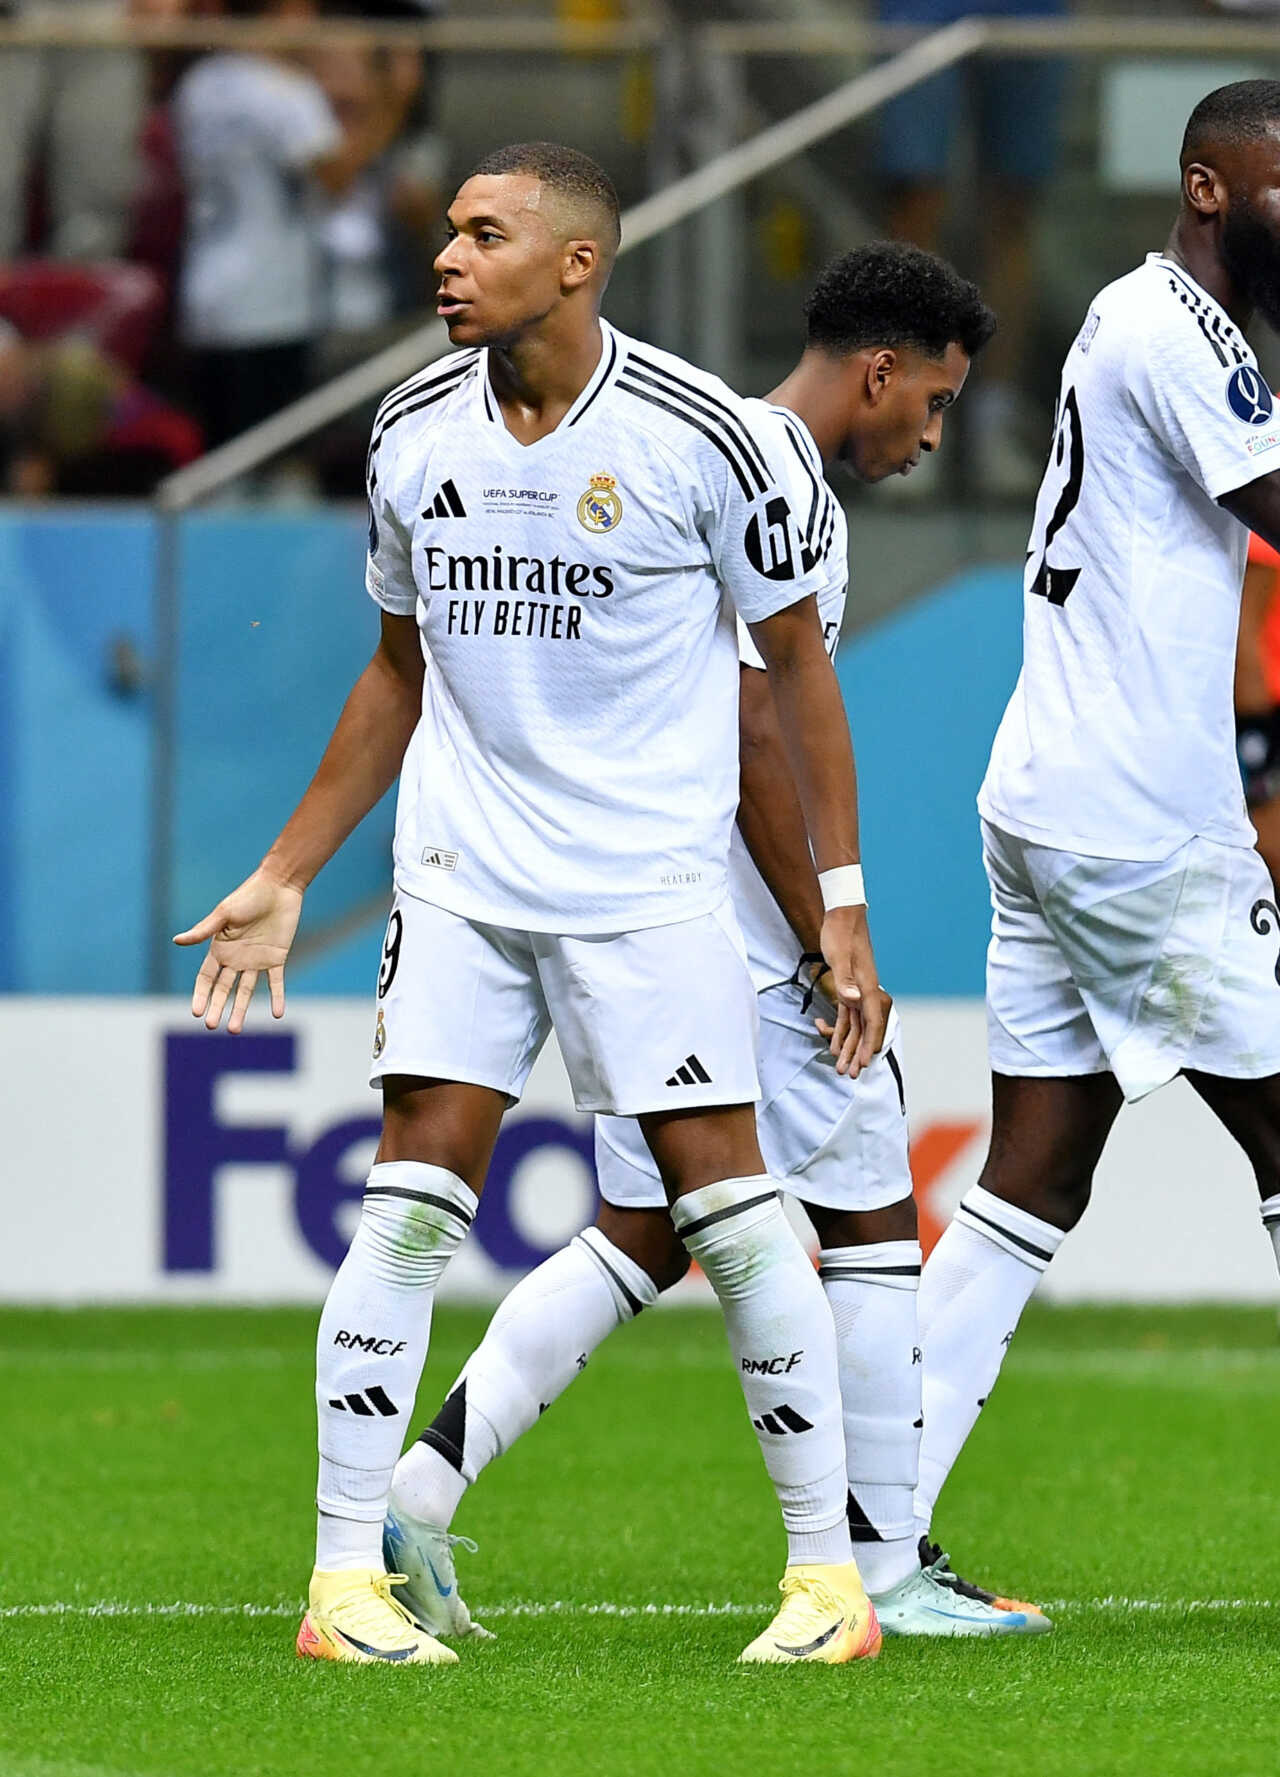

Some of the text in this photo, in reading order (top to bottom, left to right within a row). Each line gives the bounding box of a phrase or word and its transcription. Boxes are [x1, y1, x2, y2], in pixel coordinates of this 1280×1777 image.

[483, 489, 558, 504] UEFA SUPER CUP
[423, 545, 614, 598] Emirates
[448, 600, 582, 640] FLY BETTER
[379, 909, 403, 1000] 9
[333, 1329, 408, 1357] RMCF
[741, 1350, 804, 1376] RMCF
